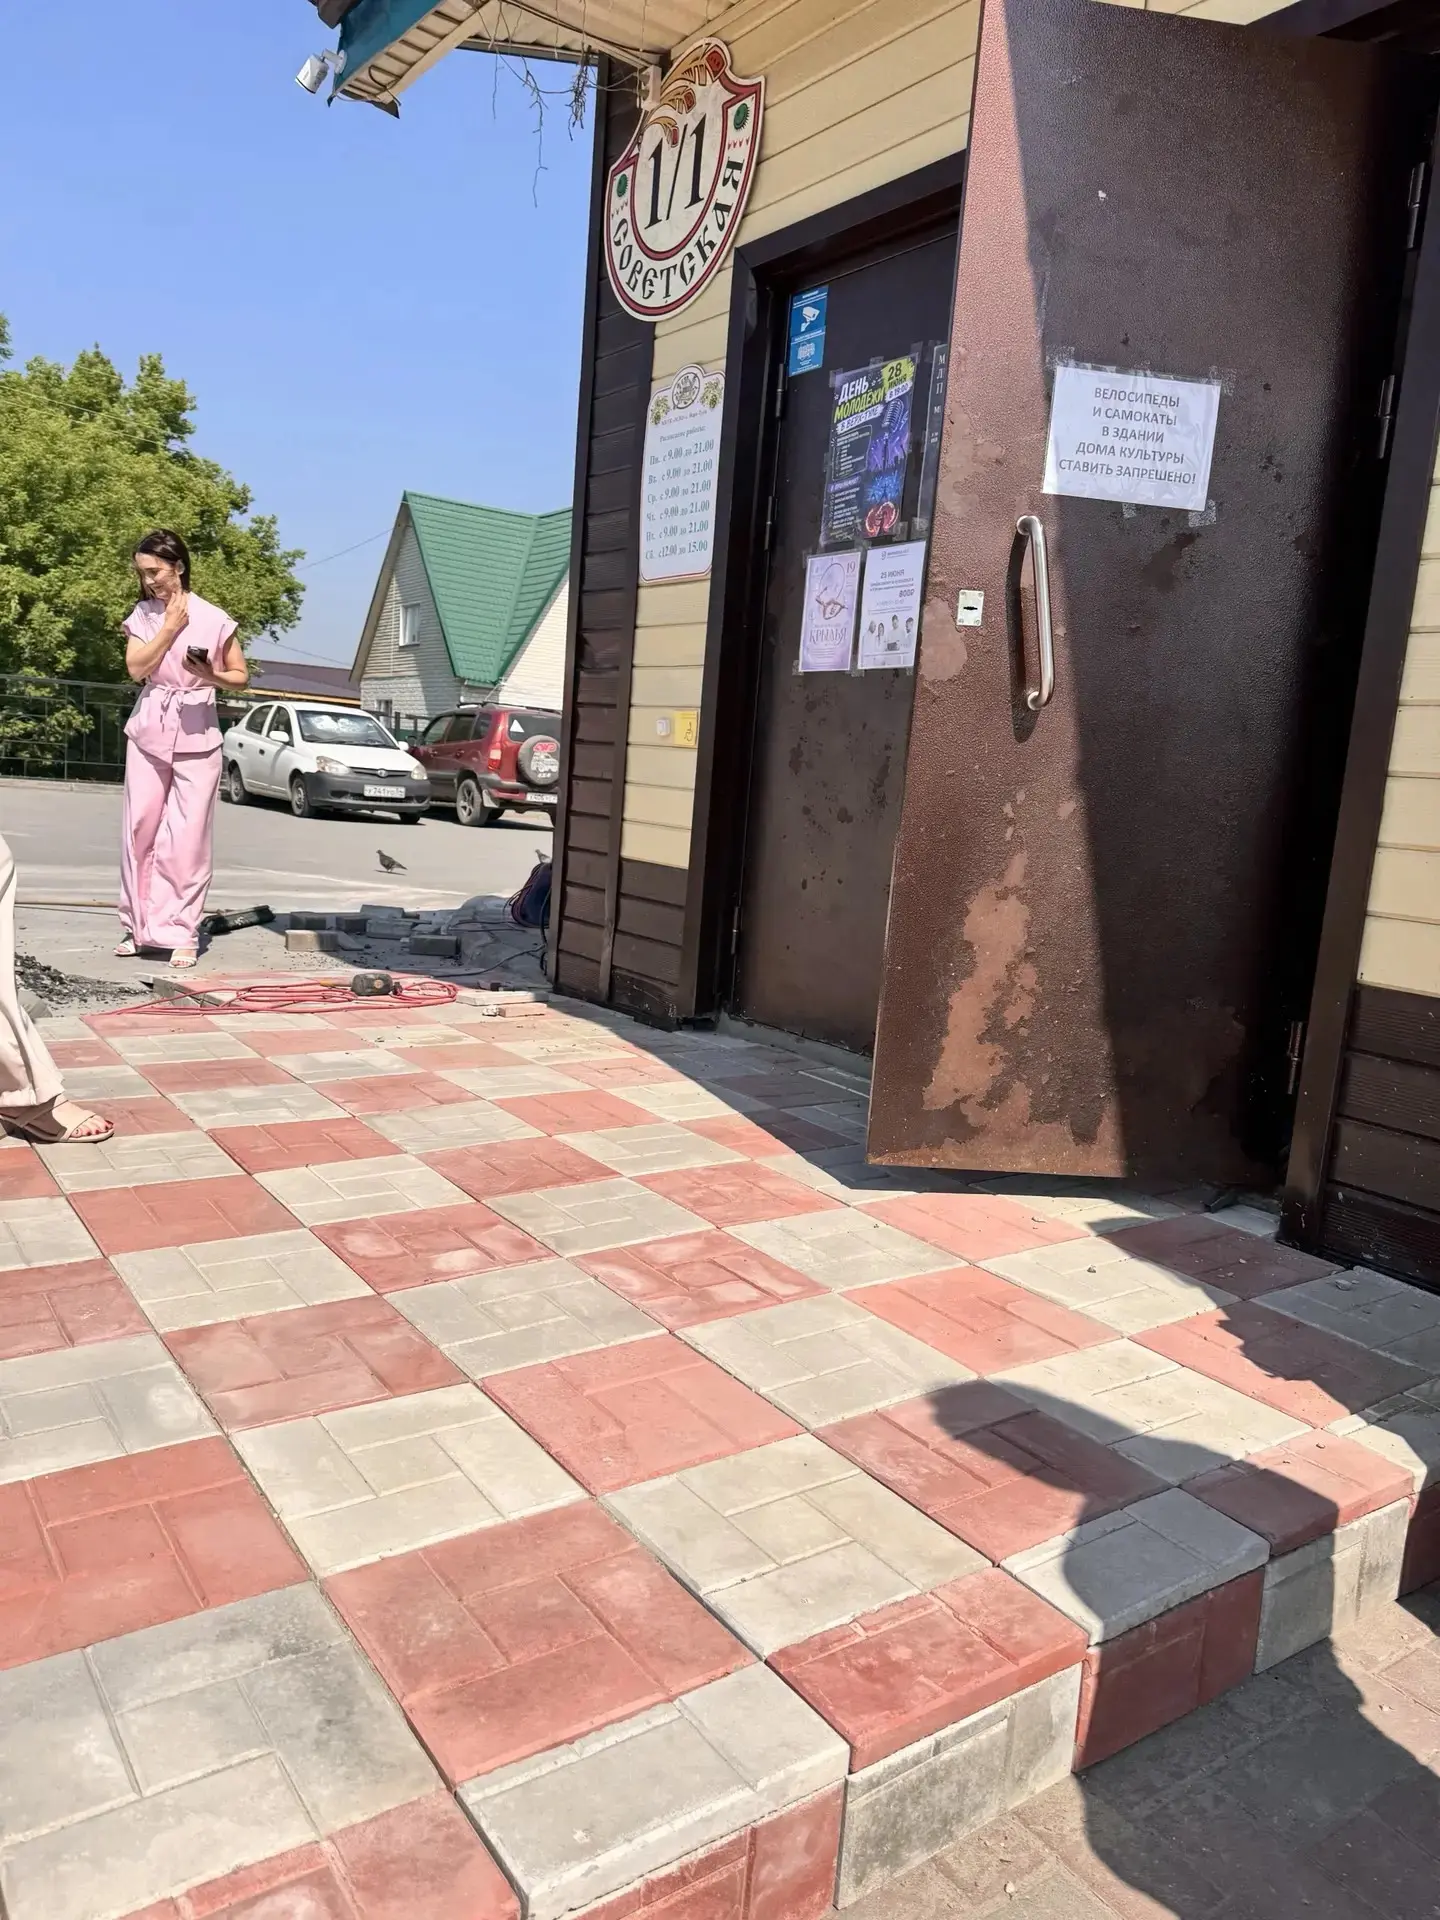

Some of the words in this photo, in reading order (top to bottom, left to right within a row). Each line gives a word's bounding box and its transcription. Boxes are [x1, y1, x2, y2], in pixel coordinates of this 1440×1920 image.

[644, 113, 707, 230] 1/1
[888, 362, 902, 382] 28
[838, 376, 869, 405] ДЕНЬ
[1094, 387, 1180, 408] ВЕЛОСИПЕДЫ
[834, 387, 886, 424] МОЛОДЁЖИ
[1092, 406, 1102, 417] И
[1104, 407, 1177, 426] САМОКАТЫ
[1101, 425, 1109, 437] В
[1112, 427, 1165, 443] ЗДАНИИ
[650, 455, 660, 466] Пн.
[694, 440, 714, 454] 21.00
[1075, 441, 1116, 457] ДОМА
[1119, 446, 1184, 465] КУЛЬТУРЫ
[692, 459, 712, 474] 21.00
[1058, 459, 1113, 475] СТАВИТЬ
[690, 480, 711, 494] 21.00
[690, 500, 710, 514] 21.00
[688, 520, 709, 534] 21.00
[688, 540, 708, 554] 15.00
